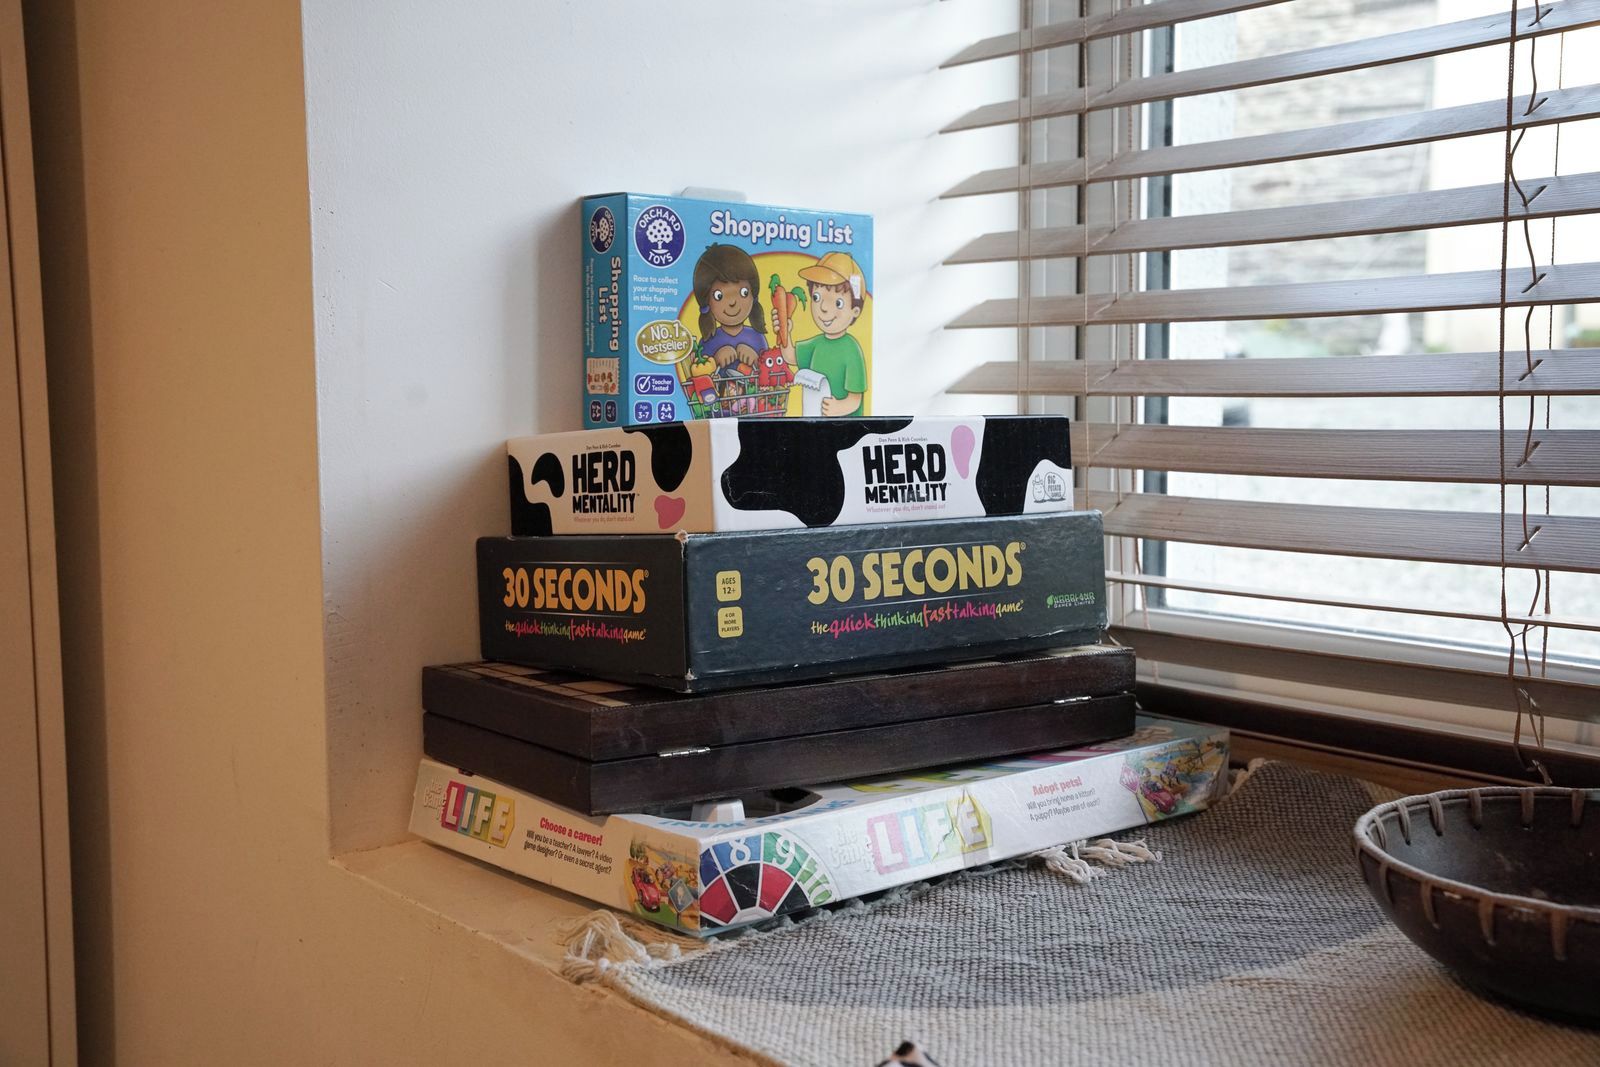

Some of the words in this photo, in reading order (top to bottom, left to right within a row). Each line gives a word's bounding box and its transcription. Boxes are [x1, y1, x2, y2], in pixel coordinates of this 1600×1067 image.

[639, 208, 681, 232] ORCHARD
[709, 209, 812, 248] Shopping
[816, 218, 854, 245] List
[648, 251, 673, 264] TOYS
[633, 274, 648, 282] Race
[658, 276, 678, 284] collect
[648, 285, 678, 296] shopping
[599, 286, 609, 323] List
[609, 256, 622, 351] Shopping
[642, 340, 688, 354] bestseller
[572, 450, 636, 494] HERD
[862, 443, 946, 484] HERD
[572, 493, 636, 513] MENTALITY
[865, 483, 947, 504] MENTALITY
[502, 567, 530, 608] 30
[723, 586, 736, 594] 12+
[806, 555, 855, 605] 30
[1032, 782, 1059, 796] Adopt
[1059, 776, 1083, 792] pets!
[445, 786, 510, 842] LIFE
[1035, 808, 1053, 821] puppy?
[1053, 807, 1070, 816] Maybe
[1037, 799, 1047, 809] you
[1047, 796, 1061, 806] bring
[540, 817, 566, 835] Choose
[568, 829, 572, 837] a
[574, 830, 603, 846] career!
[873, 800, 986, 867] LIFE
[524, 840, 536, 851] game
[537, 843, 558, 857] designer?
[558, 850, 563, 859] Or
[564, 855, 575, 863] even
[579, 858, 594, 870] secret
[595, 864, 612, 874] agent?
[543, 835, 548, 843] be
[553, 839, 572, 851] teacher?
[600, 853, 612, 864] video
[772, 836, 796, 869] 9
